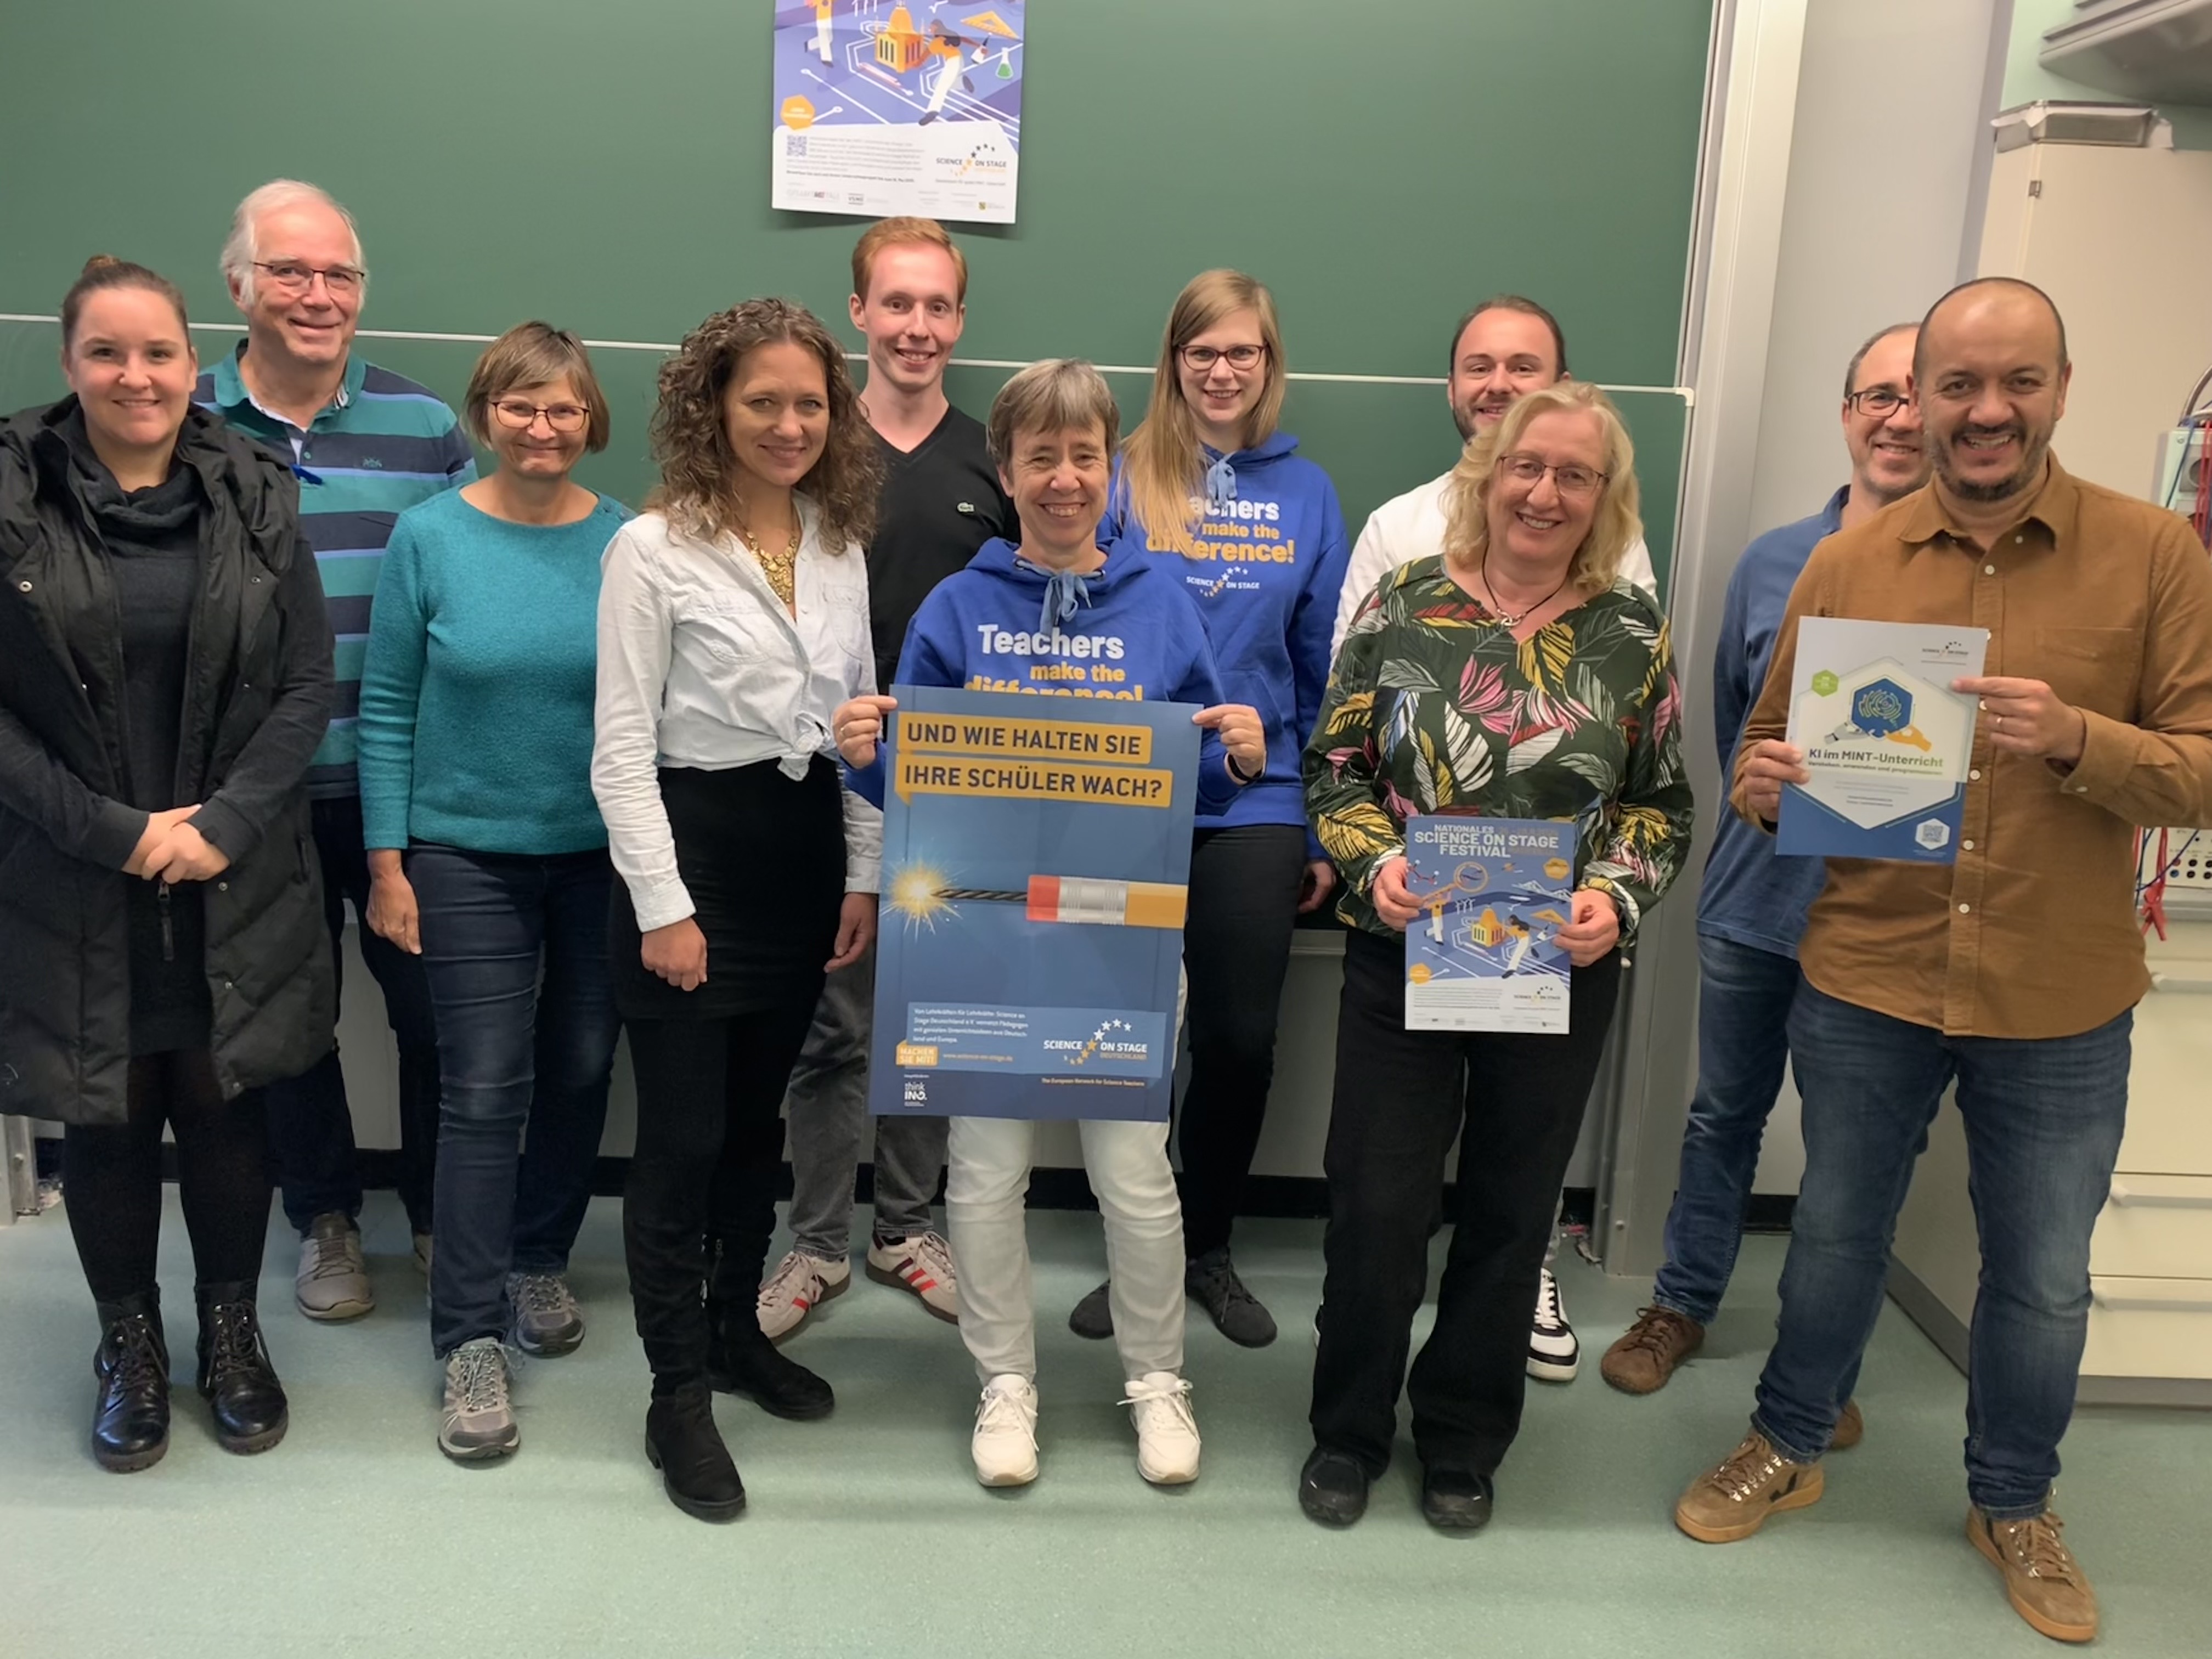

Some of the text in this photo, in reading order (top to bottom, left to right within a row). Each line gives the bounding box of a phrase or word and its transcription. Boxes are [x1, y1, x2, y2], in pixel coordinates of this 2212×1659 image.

[1189, 496, 1280, 521] achers
[1202, 521, 1280, 540] make the
[1186, 576, 1214, 586] SCIENCE
[977, 623, 1125, 659] Teachers
[1030, 661, 1125, 682] make the
[907, 721, 1142, 756] UND WIE HALTEN SIE
[1809, 748, 1944, 767] KI im MINT-Unterricht
[905, 765, 1163, 799] IHRE SCHÜLER WACH?
[1434, 824, 1494, 834] NATIONALES
[1414, 831, 1559, 849] SCIENCE ON STAGE
[1440, 844, 1511, 858] FESTIVAL
[1043, 1040, 1148, 1053] SCIENCE ON STAGE
[1100, 1052, 1148, 1060] DEUTSCHLAND
[904, 1081, 925, 1091] think
